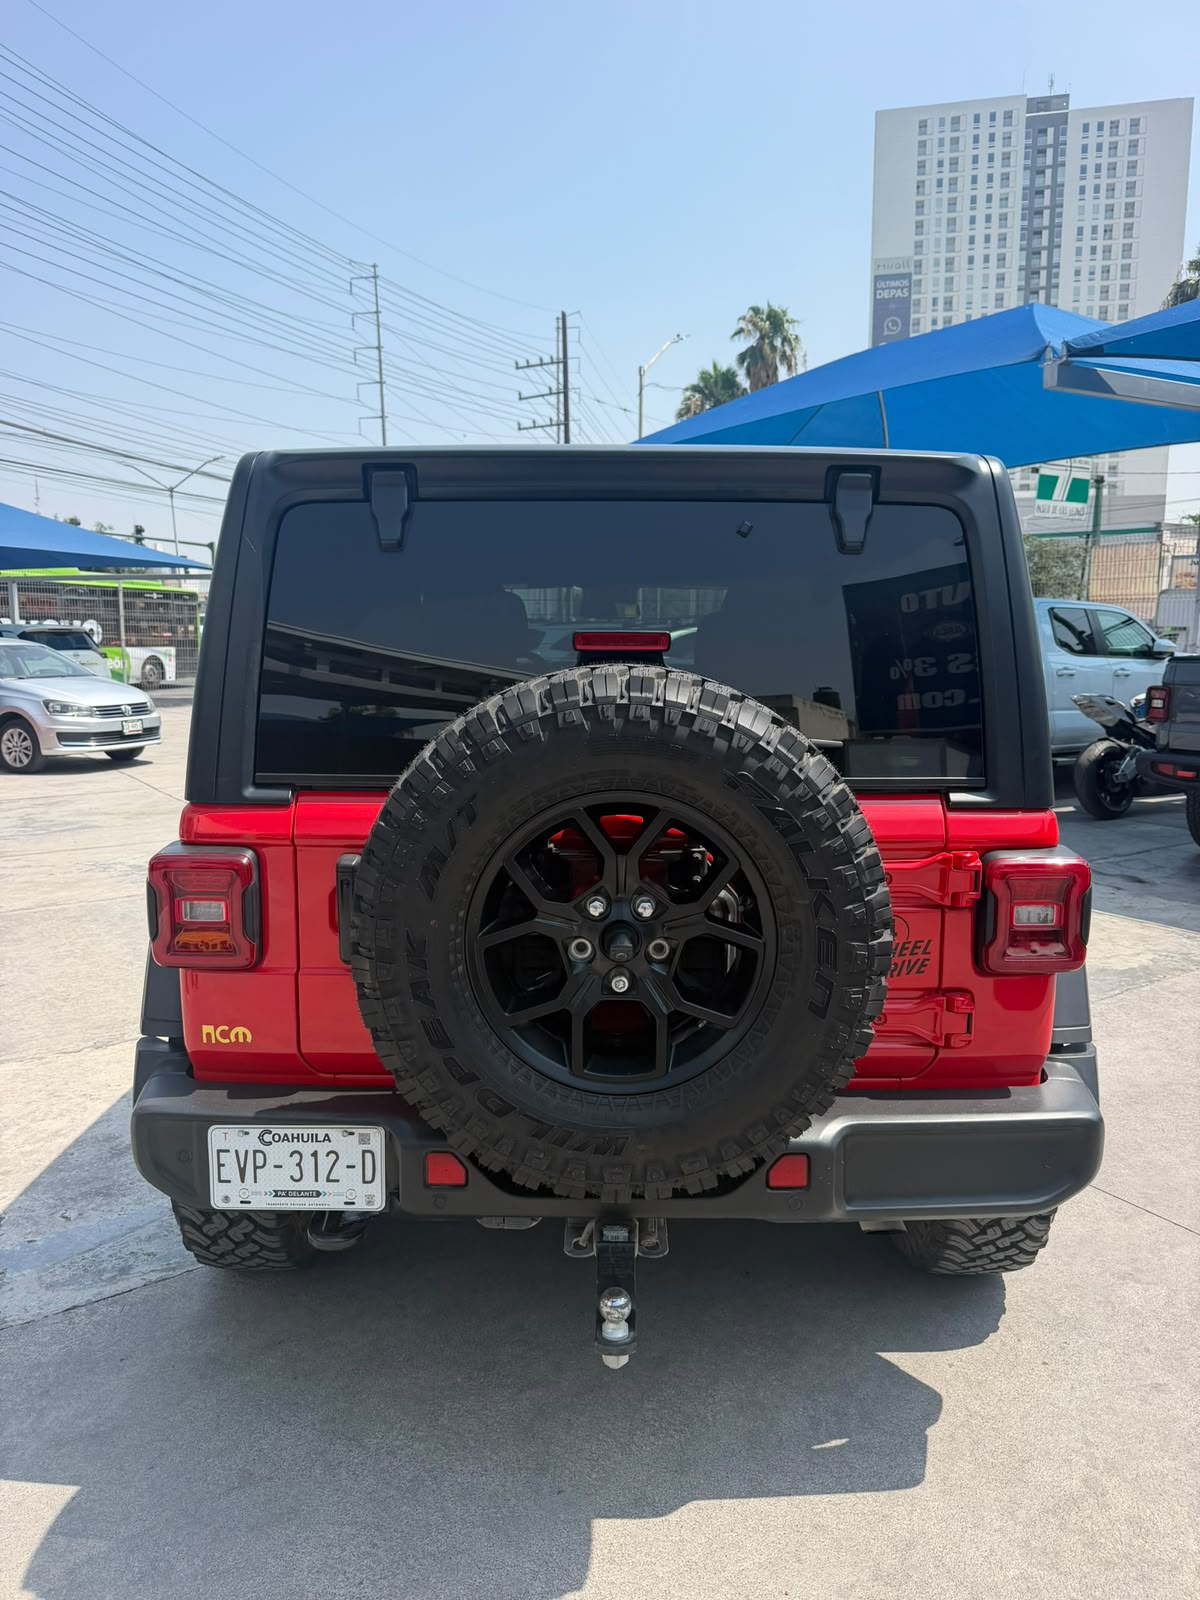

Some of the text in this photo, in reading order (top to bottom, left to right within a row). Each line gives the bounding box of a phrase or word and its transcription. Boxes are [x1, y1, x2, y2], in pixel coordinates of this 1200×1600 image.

[876, 288, 909, 299] DEPAS
[888, 958, 930, 979] RIVE
[258, 1129, 331, 1146] COAHUILA
[217, 1149, 376, 1184] EVP-312-D
